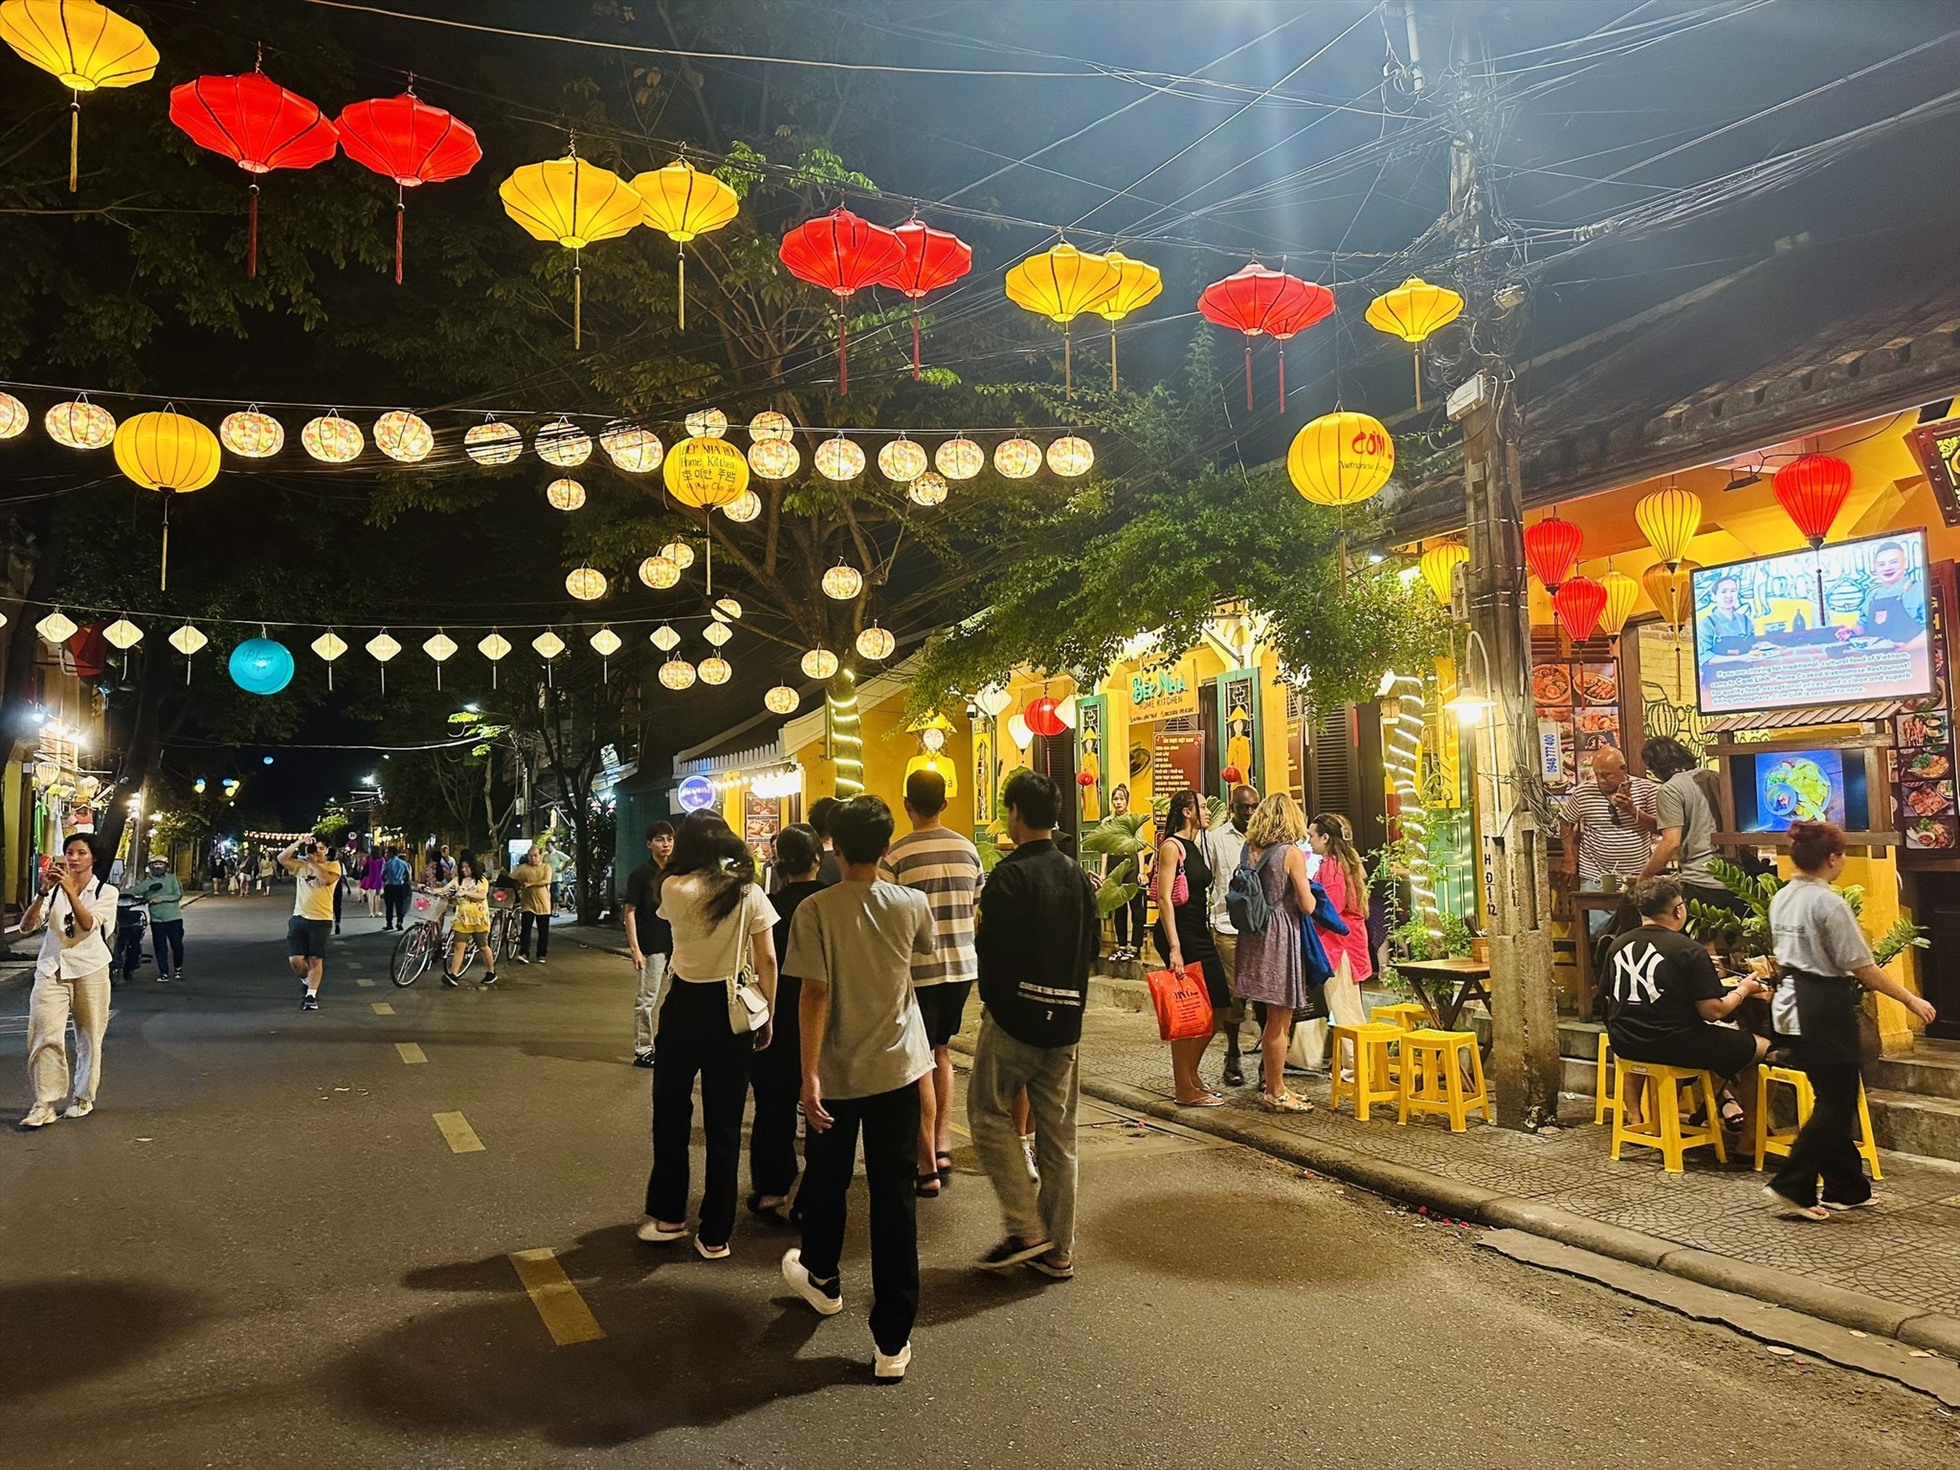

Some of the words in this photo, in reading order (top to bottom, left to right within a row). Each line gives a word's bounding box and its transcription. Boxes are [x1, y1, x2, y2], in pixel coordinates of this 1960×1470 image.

[707, 456, 735, 469] Kitchen
[1822, 658, 1849, 666] cultural
[1824, 668, 1865, 676] Vietnamese
[1763, 683, 1801, 691] exceptional
[1885, 673, 1911, 681] superb
[1156, 695, 1183, 707] KITCHEN
[1545, 747, 1556, 757] 777
[1613, 941, 1665, 1004] NY
